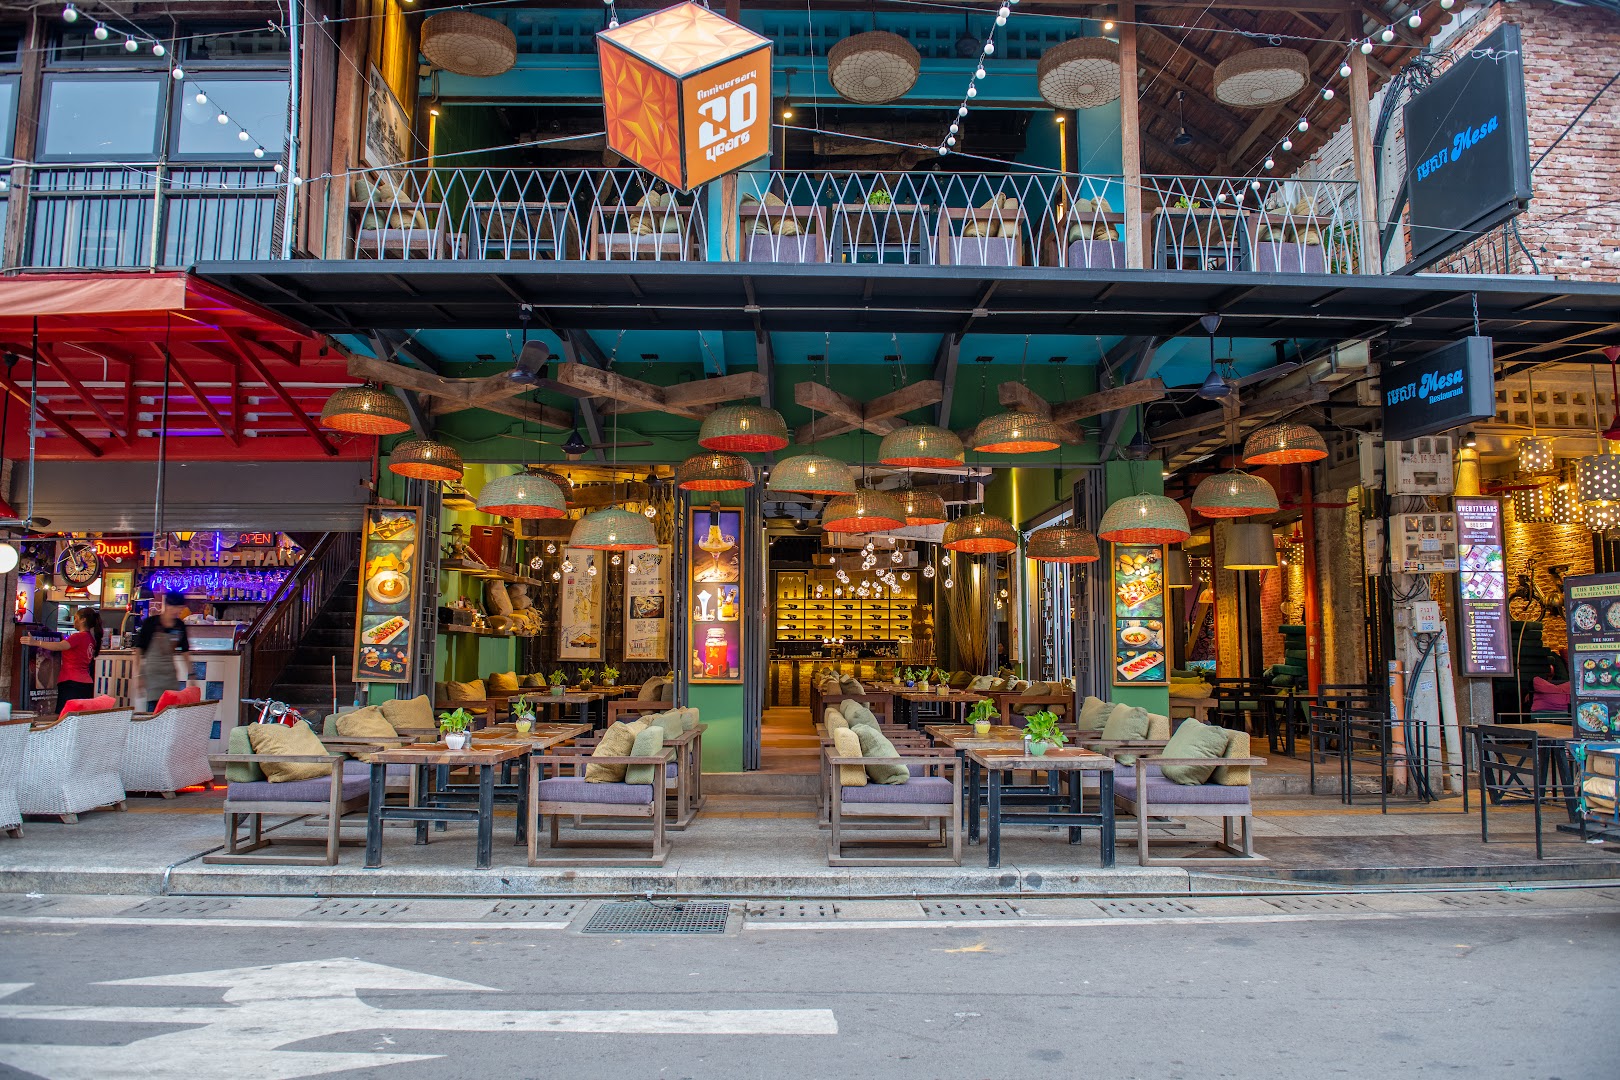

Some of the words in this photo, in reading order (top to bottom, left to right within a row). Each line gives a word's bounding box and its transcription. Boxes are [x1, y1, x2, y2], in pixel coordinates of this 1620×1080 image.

[697, 69, 757, 101] Anniversary
[697, 82, 758, 149] 20
[705, 130, 750, 163] years
[1450, 115, 1499, 162] Mesa
[1418, 368, 1464, 399] Mesa
[1429, 385, 1463, 405] Restaurant
[96, 541, 134, 555] Duvel
[240, 533, 271, 544] OPEN
[141, 550, 183, 567] THE
[190, 550, 234, 567] RED
